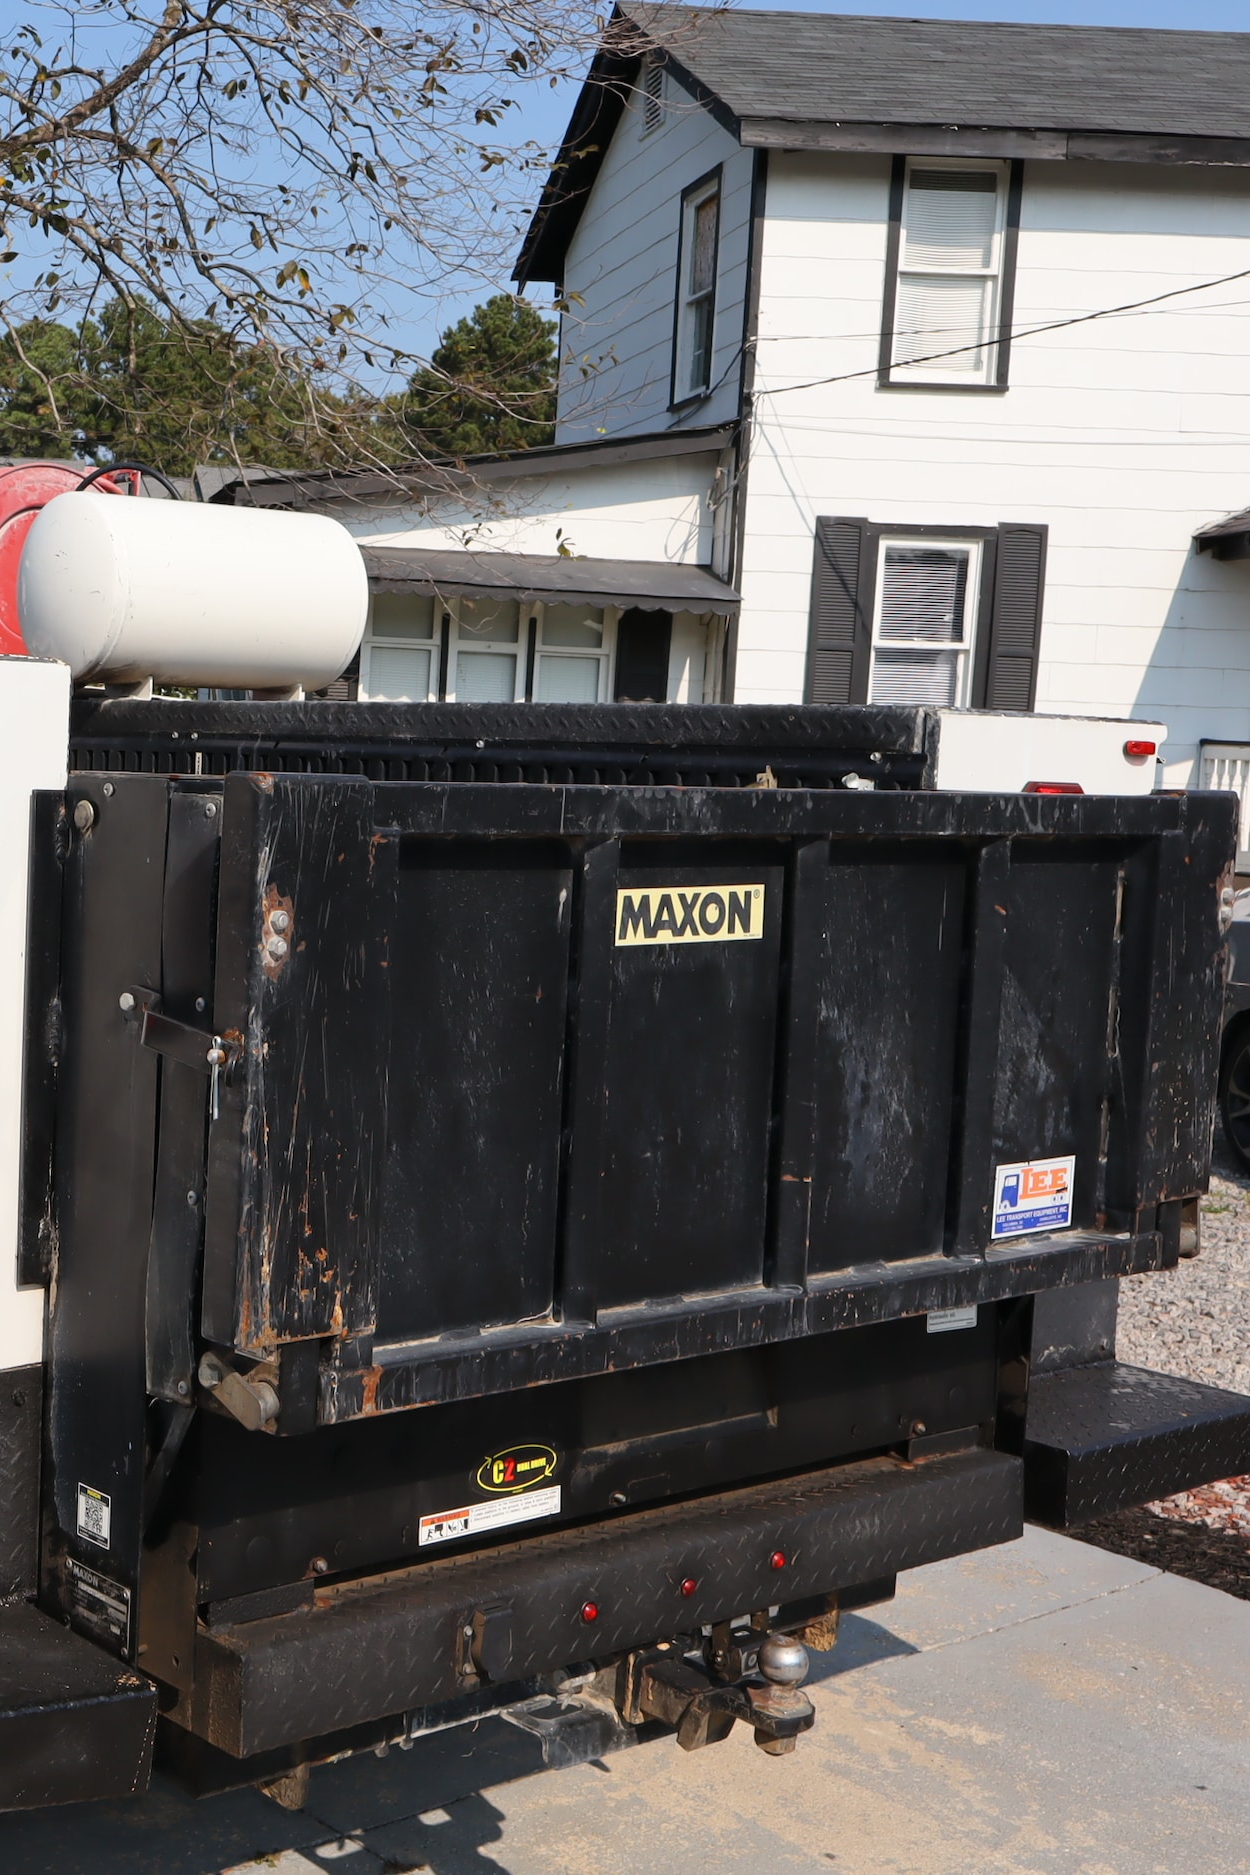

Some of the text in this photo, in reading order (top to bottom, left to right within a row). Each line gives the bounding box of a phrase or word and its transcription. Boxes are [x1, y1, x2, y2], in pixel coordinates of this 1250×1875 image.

[618, 890, 752, 940] MAXON
[1019, 1168, 1067, 1200] LEE
[1007, 1212, 1033, 1221] TRANSPORT
[492, 1457, 516, 1485] C2
[73, 1564, 99, 1587] MAXON
